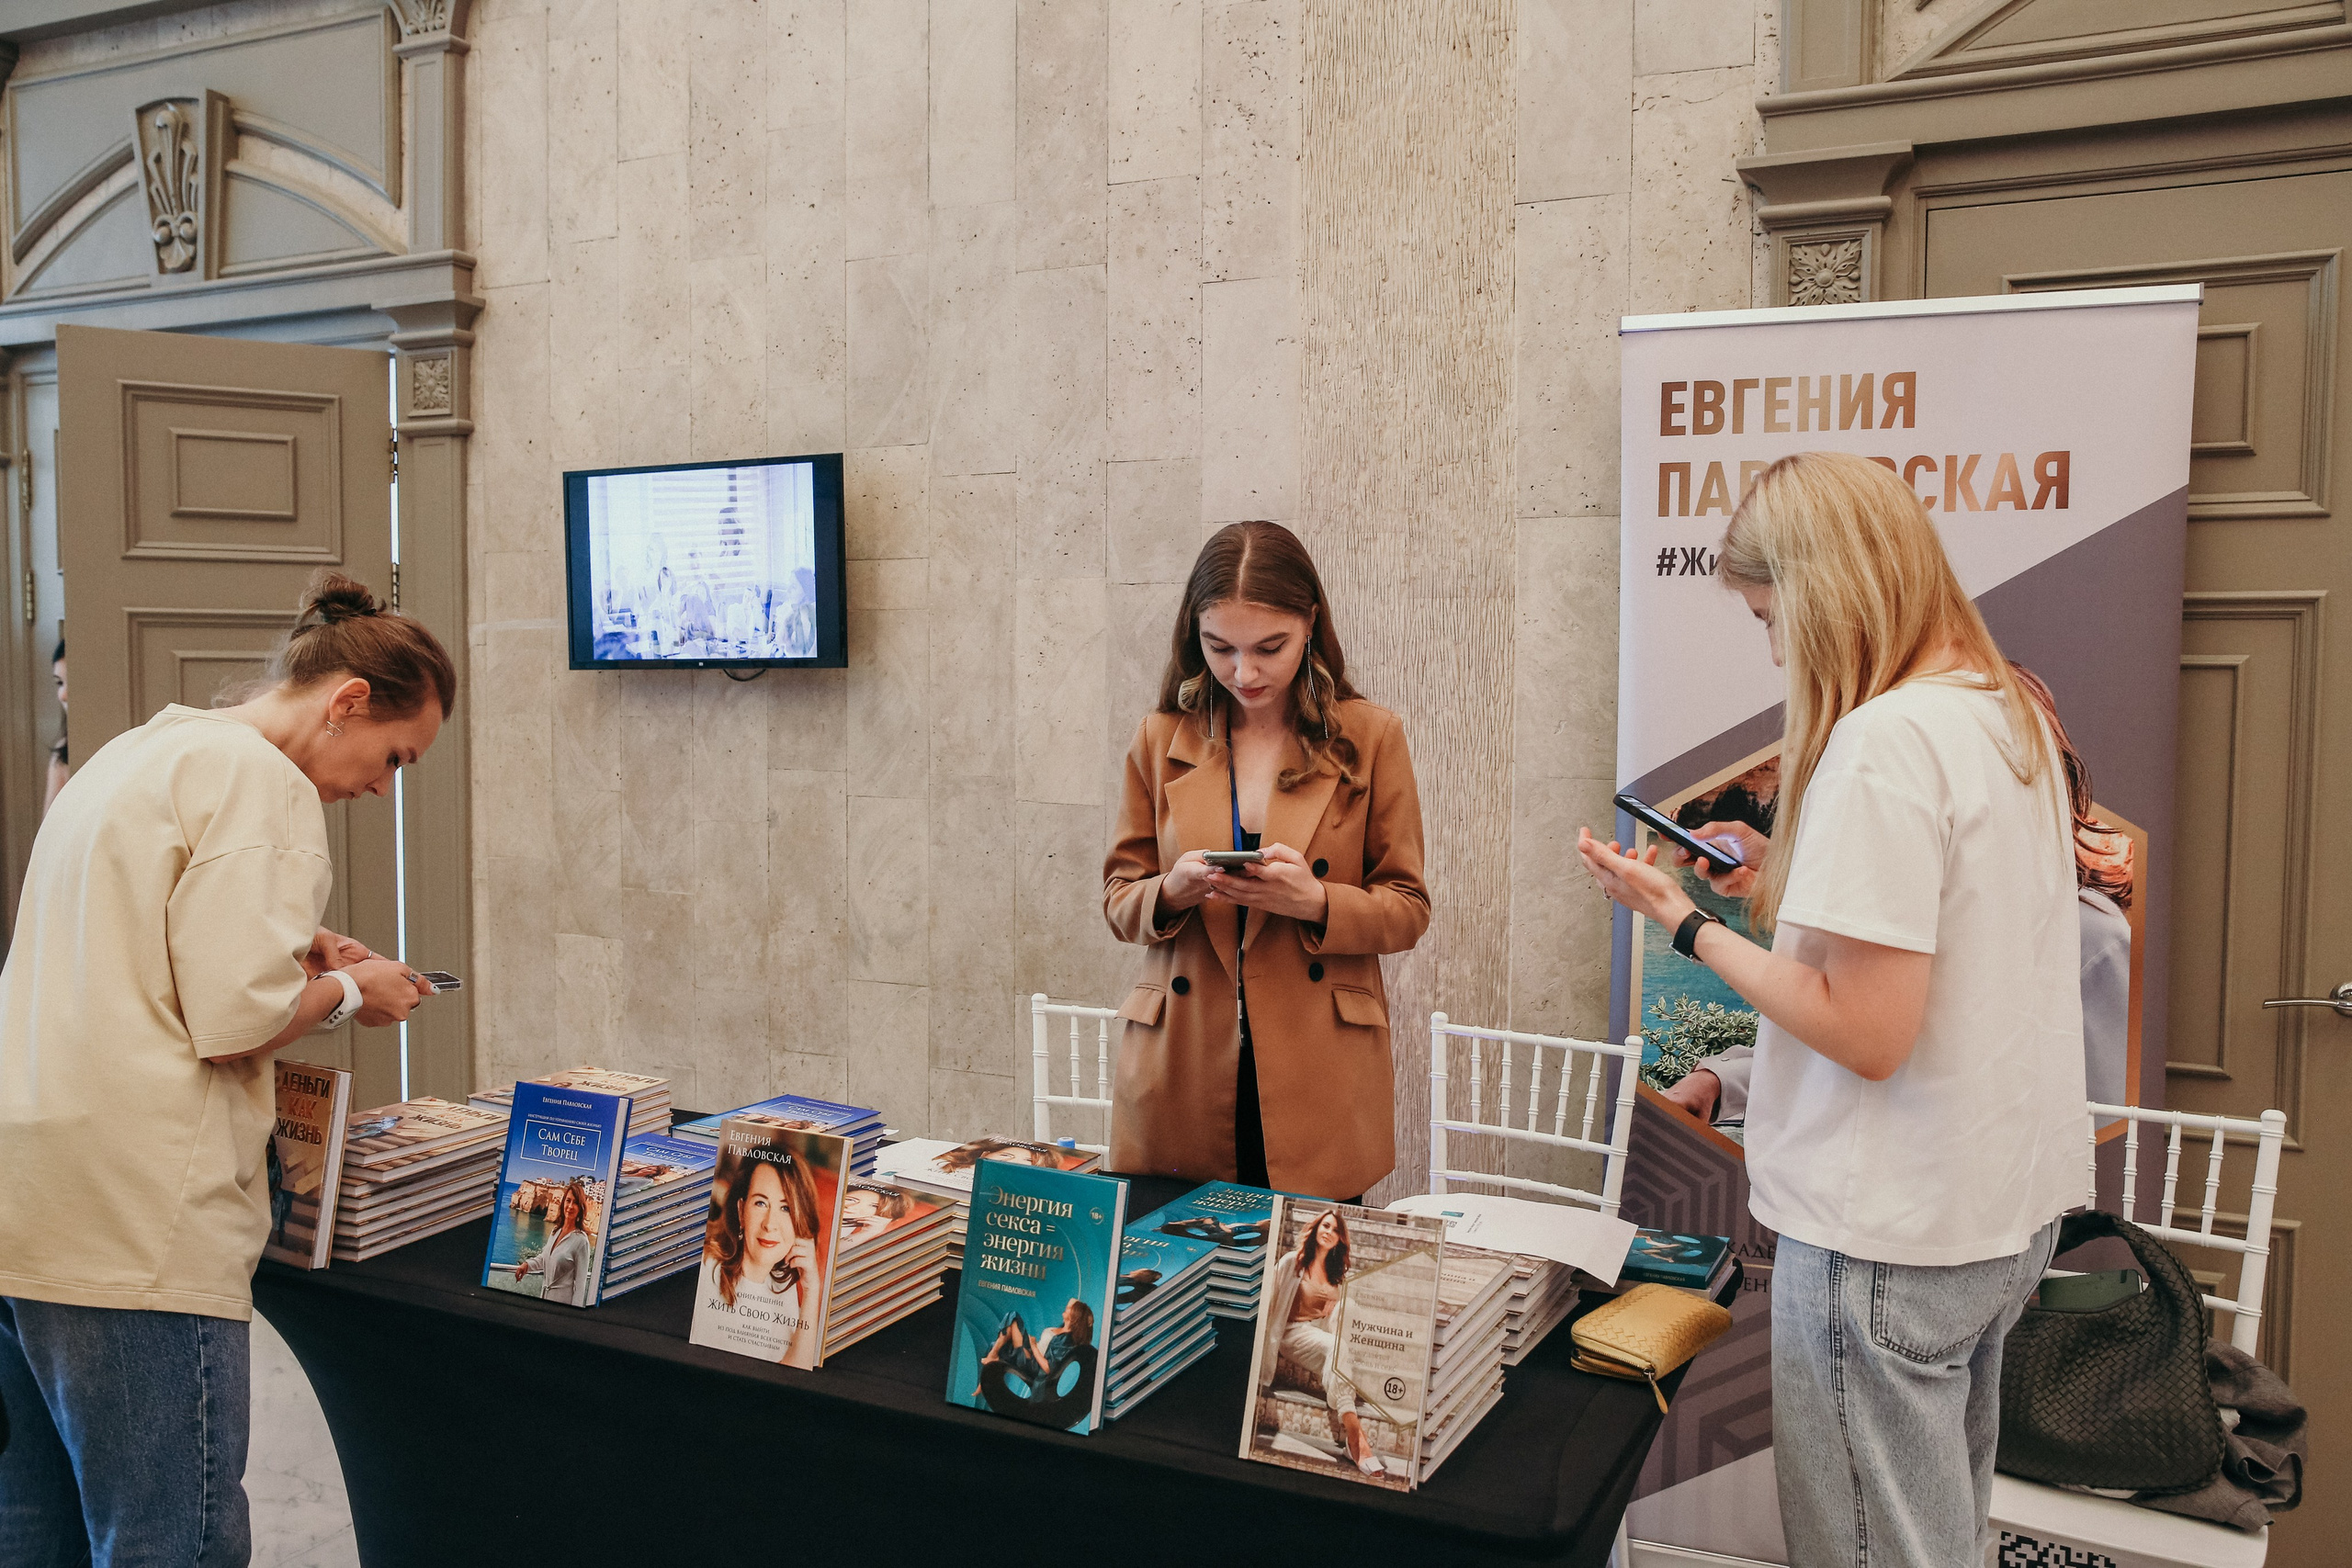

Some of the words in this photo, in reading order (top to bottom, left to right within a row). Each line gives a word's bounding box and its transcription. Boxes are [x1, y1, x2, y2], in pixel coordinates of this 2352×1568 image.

[1659, 371, 1917, 436] ЕВГЕНИЯ
[1657, 450, 2071, 517] ПАСКАЯ
[280, 1071, 331, 1099] ДЕНЬГИ
[288, 1095, 317, 1120] КАК
[276, 1117, 322, 1145] ЖИЗНЬ
[729, 1130, 772, 1146] ЕВГЕНИЯ
[728, 1144, 792, 1164] ПАВЛОВСКАЯ
[989, 1185, 1073, 1219] Энергия
[986, 1212, 1041, 1235] секса
[1091, 1212, 1102, 1220] 18+
[983, 1233, 1064, 1261] энергия
[979, 1254, 1046, 1280] жизни
[736, 1292, 784, 1307] КНИГА-РЕШЕНИЕ
[707, 1298, 736, 1314] ЖИТЬ
[739, 1304, 771, 1321] СВОЮ
[773, 1312, 809, 1330] ЖИЗНЬ
[1351, 1319, 1403, 1337] Мужчина
[1350, 1334, 1405, 1352] Женщина
[1386, 1382, 1404, 1394] 18+
